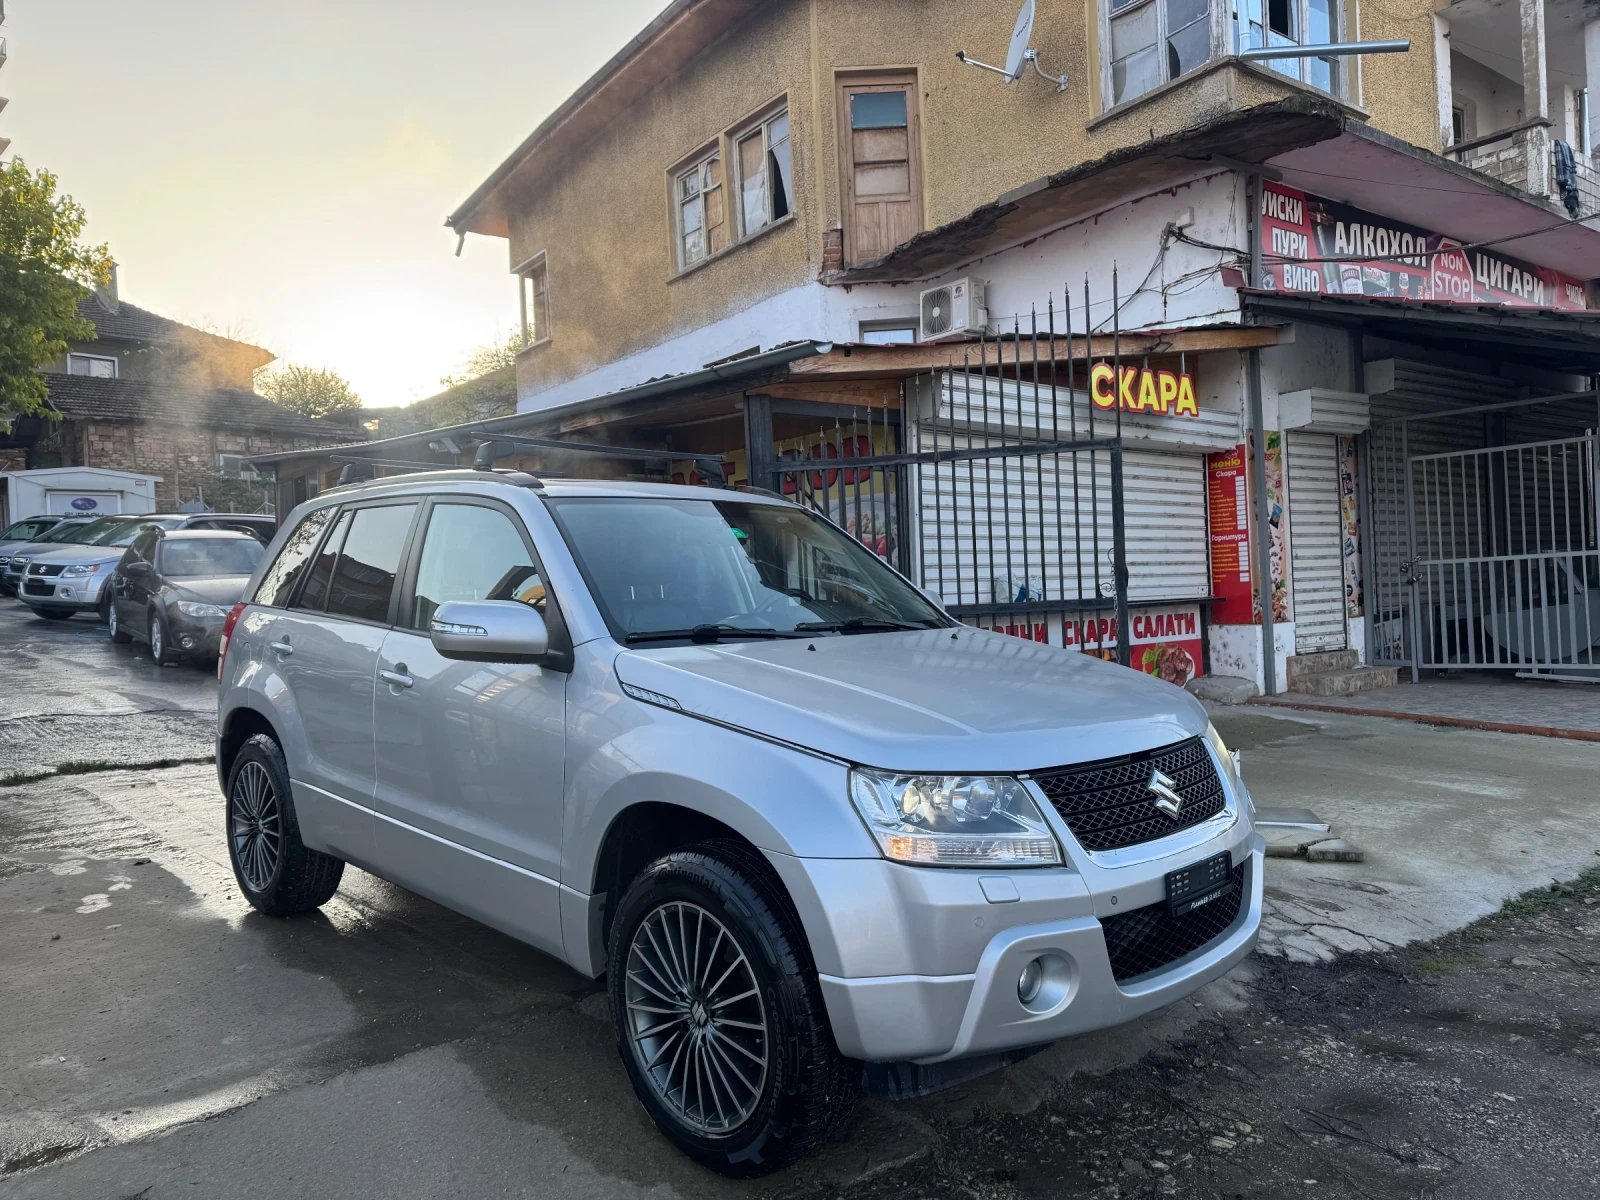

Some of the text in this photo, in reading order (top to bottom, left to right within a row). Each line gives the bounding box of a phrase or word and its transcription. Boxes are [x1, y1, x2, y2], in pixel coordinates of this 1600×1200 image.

[1262, 190, 1303, 226] УИСКИ
[1272, 226, 1308, 260] ПУРИ
[1334, 221, 1427, 267] АЛКОХОЛ
[1284, 264, 1319, 292] ВИНО
[1441, 253, 1463, 272] NON
[1435, 271, 1470, 298] STOP
[1476, 253, 1544, 306] ЦИГАРИ
[1091, 363, 1199, 416] СКАРА
[1215, 470, 1237, 478] Скара
[1133, 613, 1196, 639] САЛАТИ
